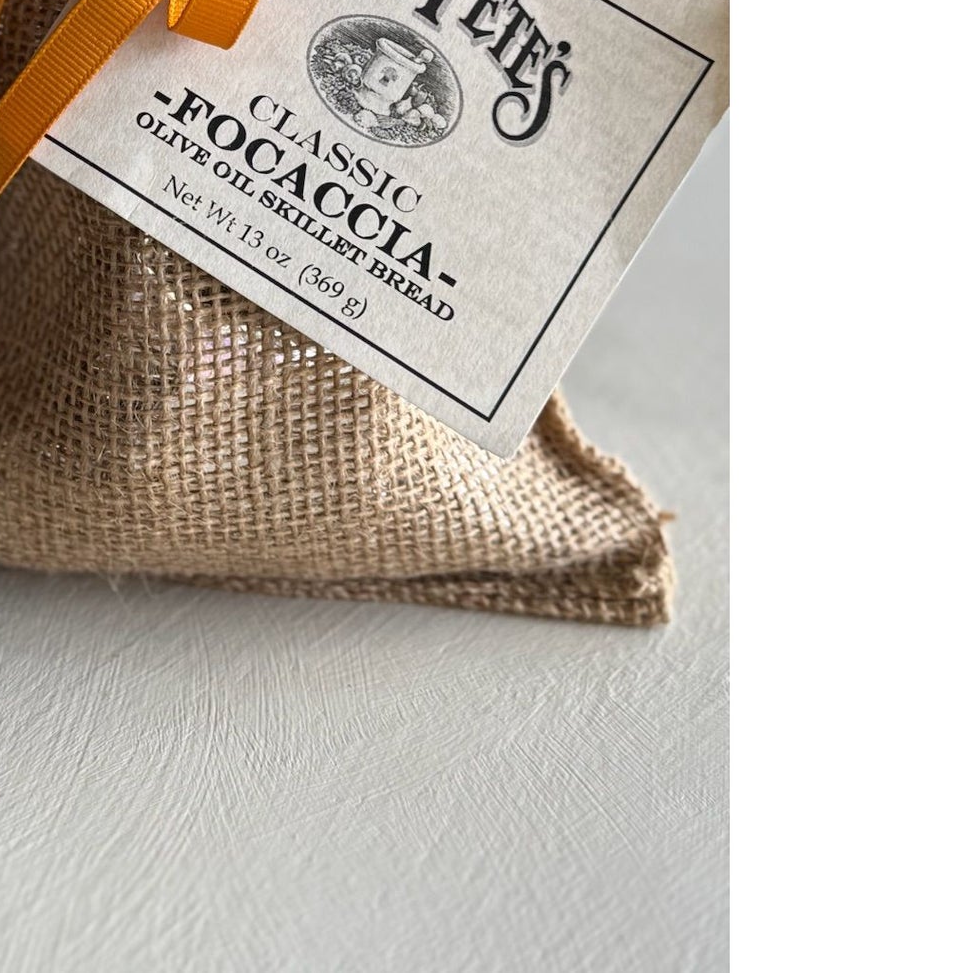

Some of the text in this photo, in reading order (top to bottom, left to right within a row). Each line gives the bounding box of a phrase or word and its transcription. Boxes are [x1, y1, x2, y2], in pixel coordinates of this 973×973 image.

[136, 110, 456, 323] OLIVE OIL SKILLET BREAD
[248, 94, 424, 214] CLASSIC
[162, 174, 368, 321] Net Wt 13 oz (369 g)
